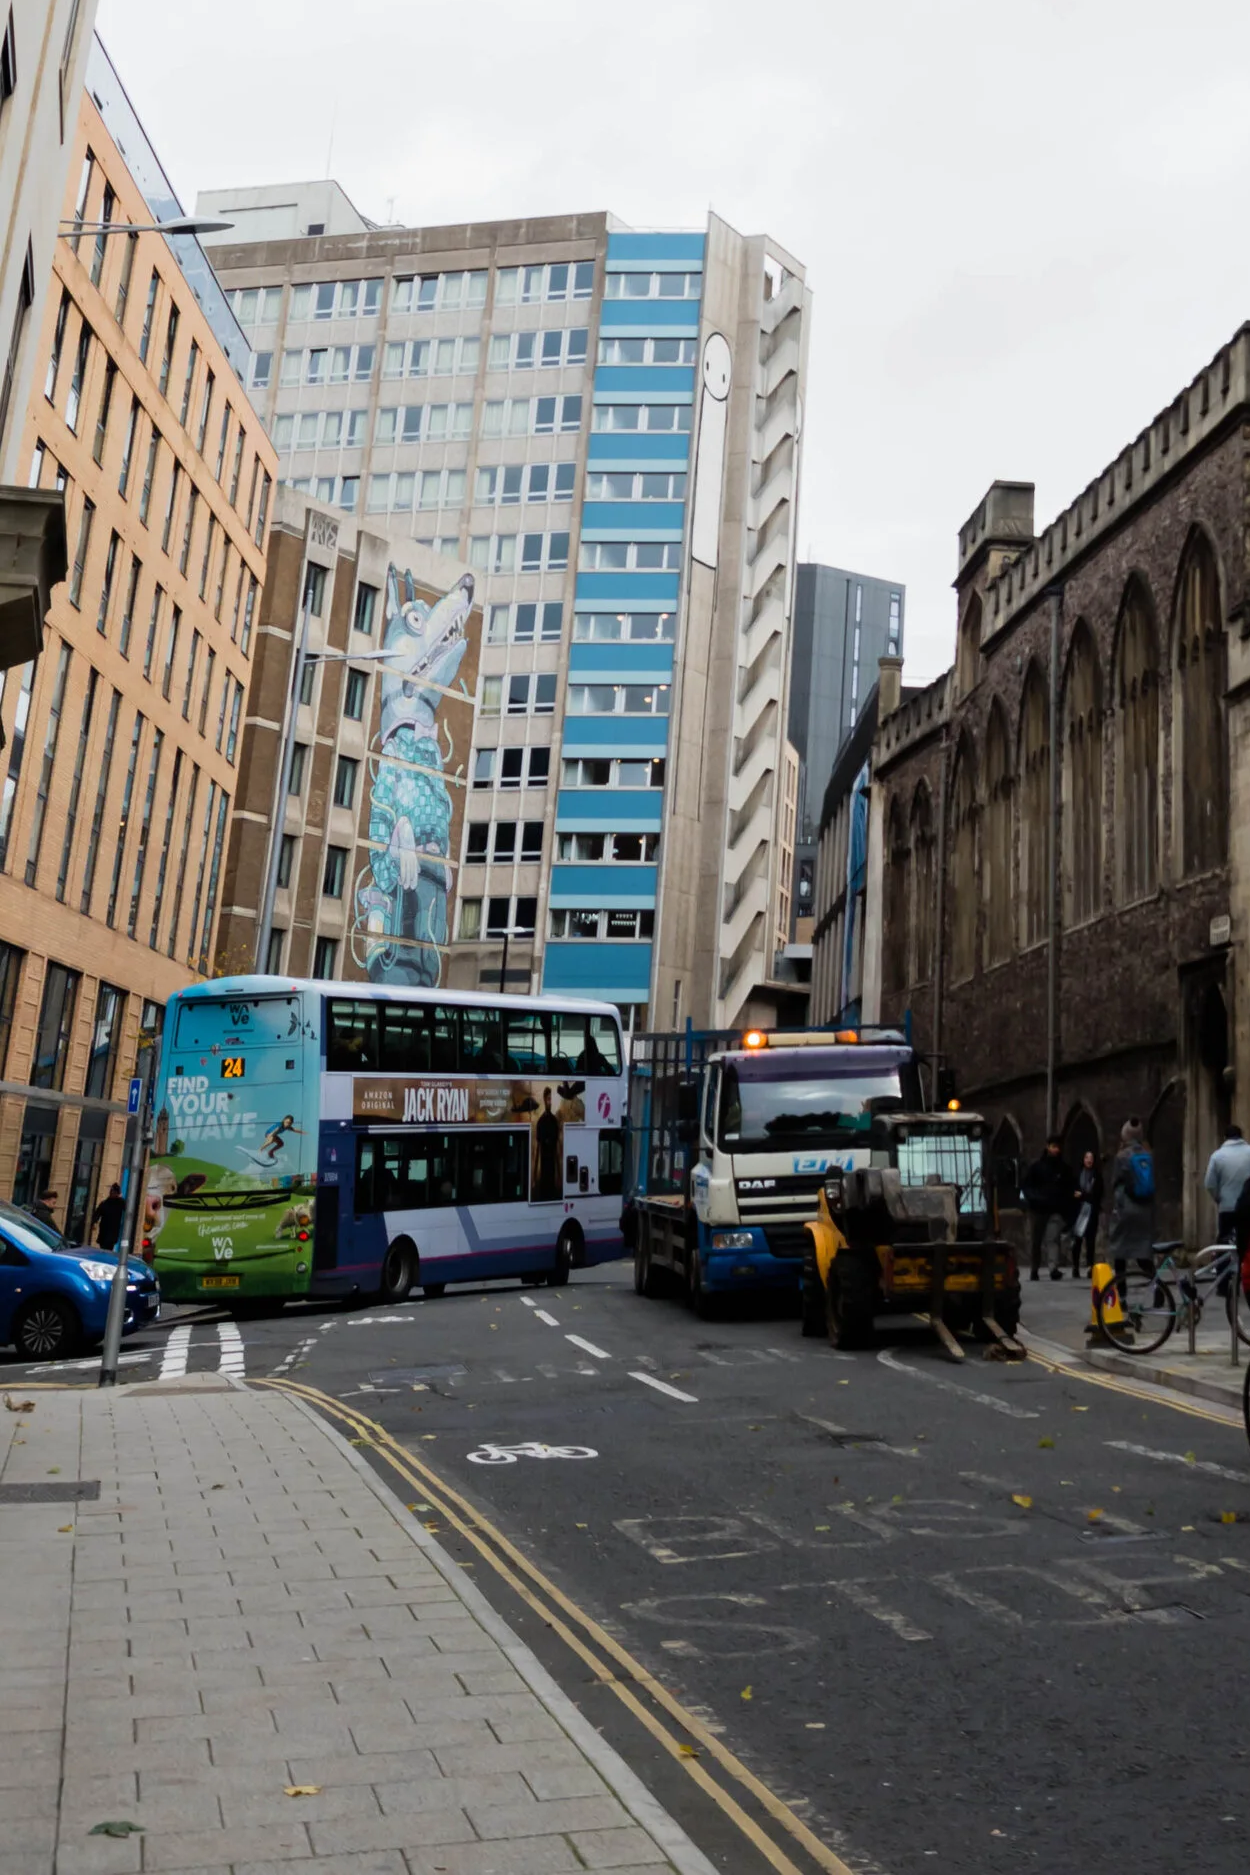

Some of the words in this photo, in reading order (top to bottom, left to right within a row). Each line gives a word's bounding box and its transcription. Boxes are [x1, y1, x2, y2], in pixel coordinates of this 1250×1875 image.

[223, 1057, 243, 1078] 24
[167, 1076, 209, 1094] FIND
[364, 1090, 393, 1099] AMAZON
[169, 1092, 230, 1115] YOUR
[361, 1099, 395, 1110] ORIGINAL
[402, 1087, 435, 1122] JACK
[436, 1088, 468, 1122] RYAN
[174, 1112, 258, 1141] WAVE
[738, 1180, 776, 1190] DAF
